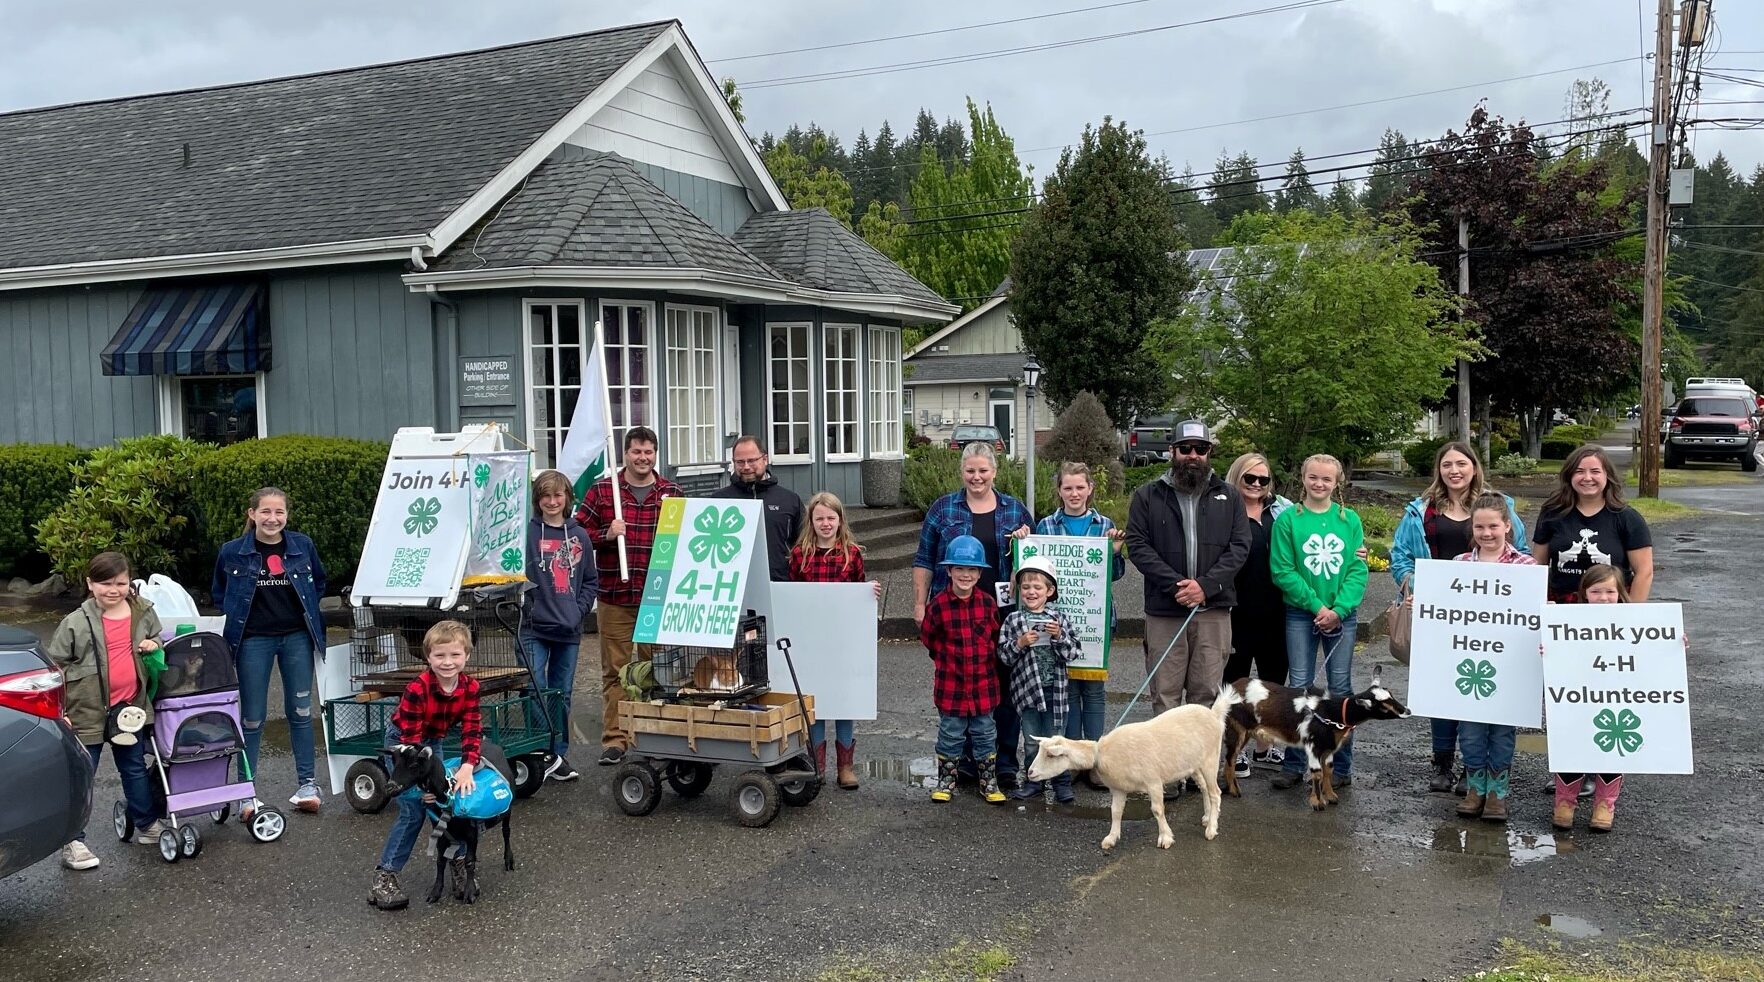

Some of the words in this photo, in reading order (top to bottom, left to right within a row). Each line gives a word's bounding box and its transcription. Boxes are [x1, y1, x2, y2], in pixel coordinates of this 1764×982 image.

[465, 361, 508, 371] HANDICAPPED
[388, 470, 434, 490] Join
[1041, 544, 1046, 556] I
[1048, 544, 1084, 558] PLEDGE
[1056, 559, 1084, 568] HEAD
[1063, 569, 1099, 579] thinking,
[674, 569, 740, 602] 4-H
[1066, 588, 1096, 598] loyalty,
[1450, 577, 1488, 595] 4-H
[1494, 578, 1512, 596] is
[662, 602, 705, 634] GROWS
[704, 604, 738, 635] HERE
[1087, 607, 1102, 615] and
[1419, 603, 1541, 631] Happening
[1085, 625, 1098, 633] for
[1547, 623, 1625, 641] Thank
[1630, 627, 1676, 645] you
[1452, 634, 1505, 653] Here
[1592, 655, 1635, 672] 4-H
[1548, 686, 1685, 704] Volunteers
